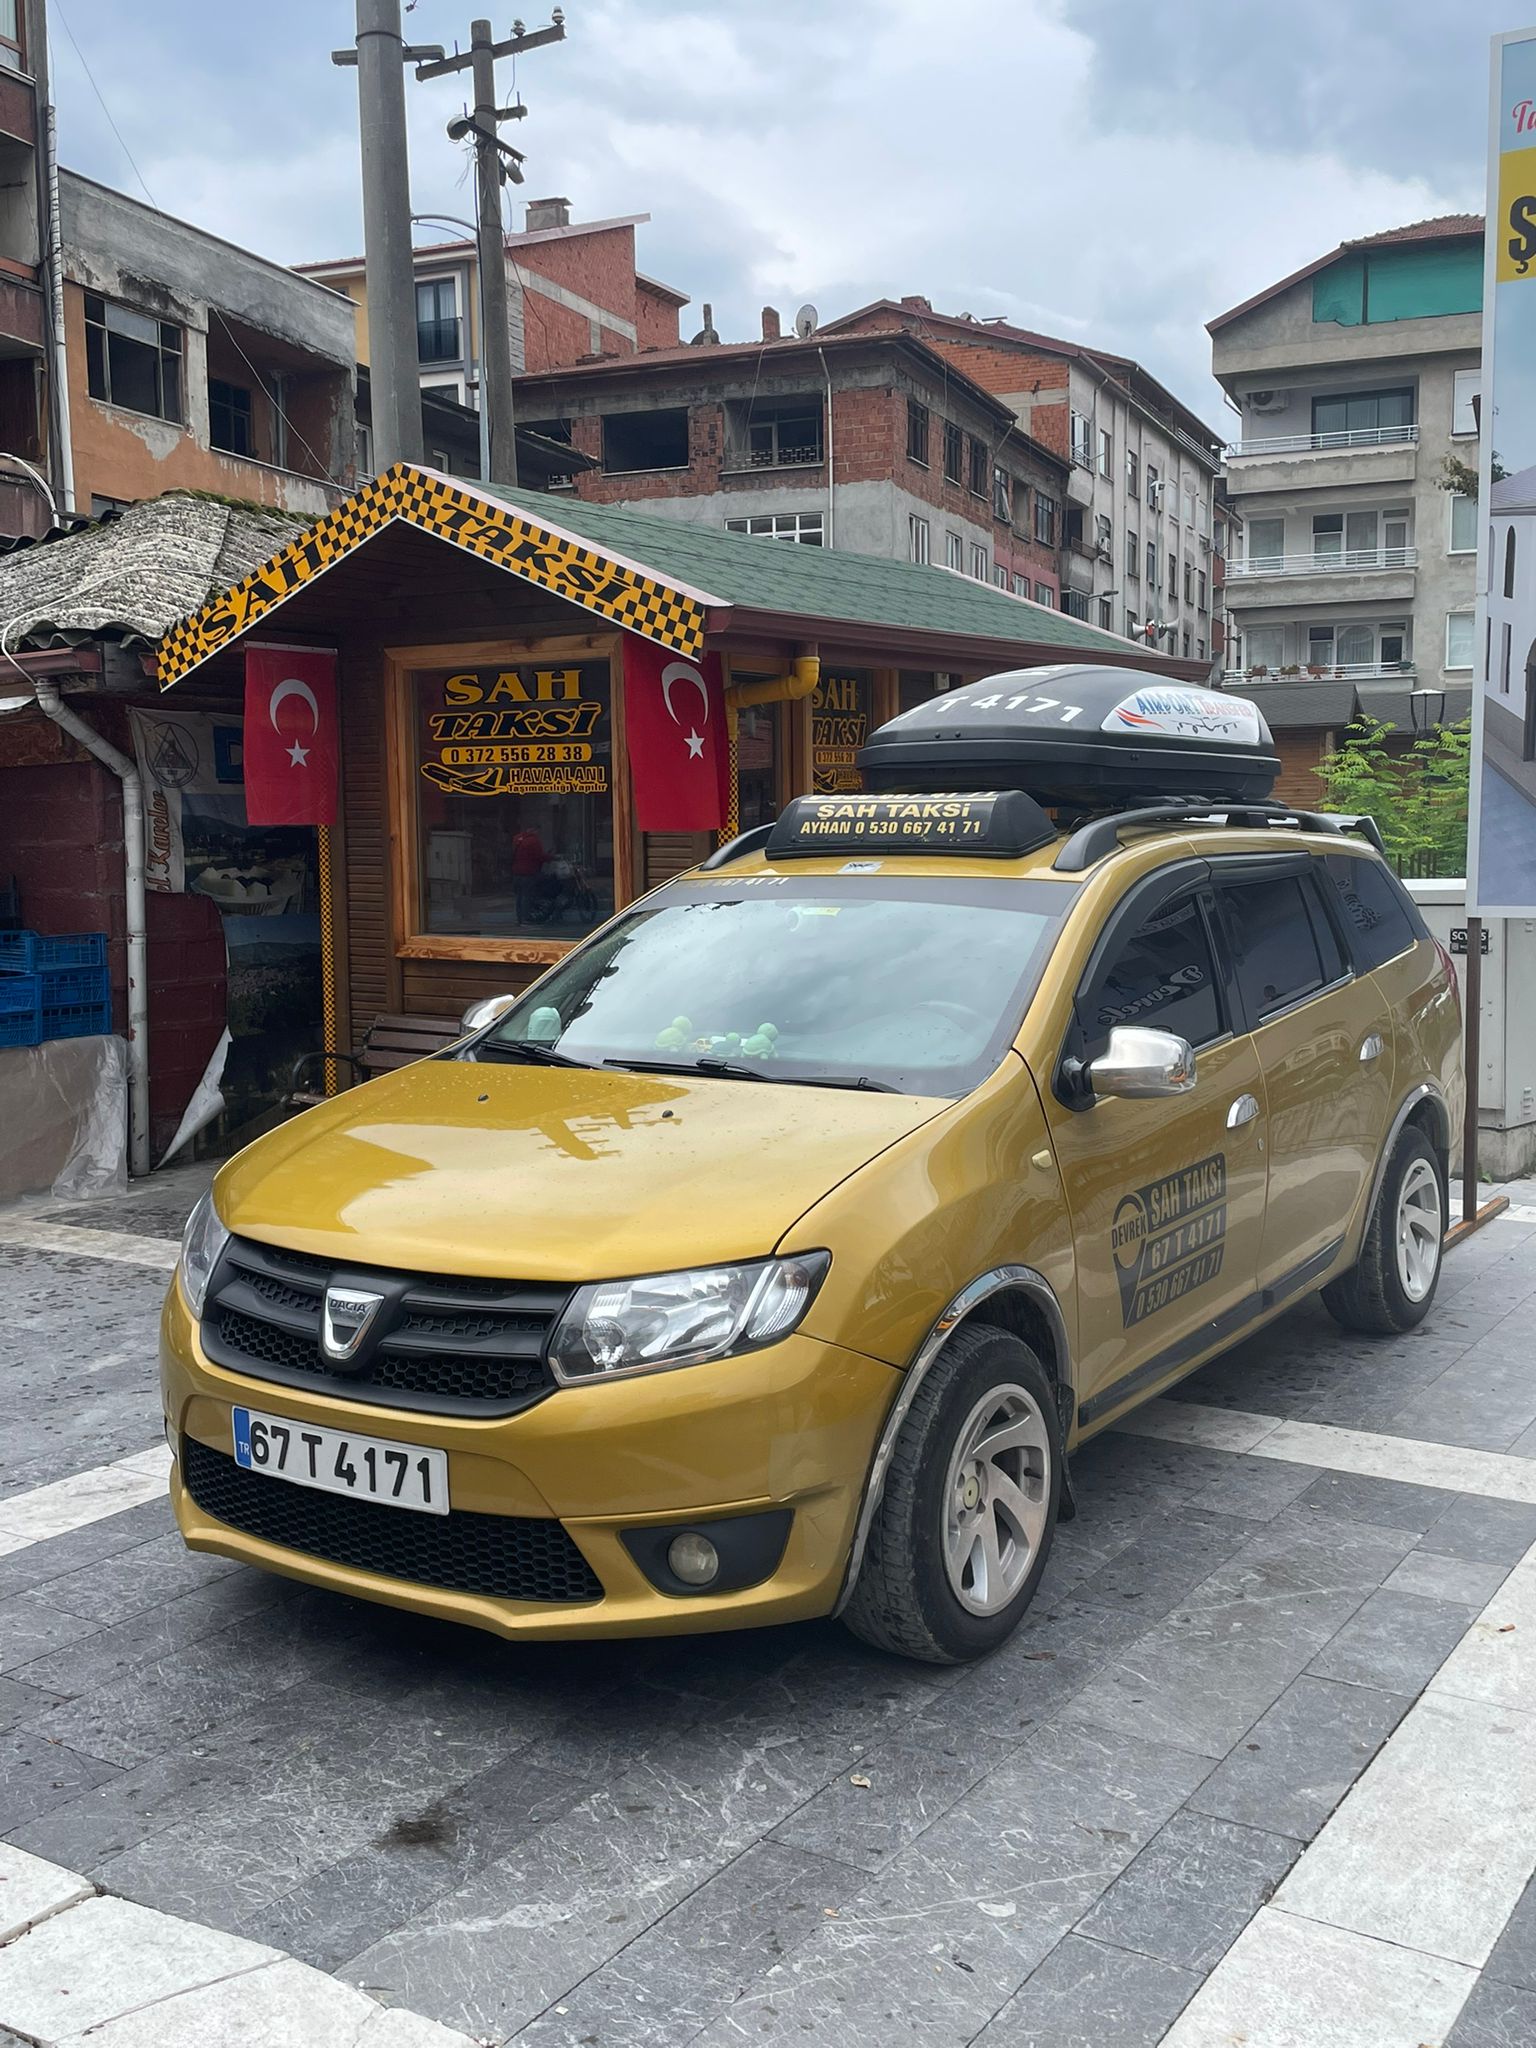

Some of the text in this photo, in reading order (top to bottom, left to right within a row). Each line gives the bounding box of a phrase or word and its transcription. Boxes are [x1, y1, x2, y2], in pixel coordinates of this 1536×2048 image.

[445, 669, 583, 706] SAH
[936, 695, 970, 713] T
[970, 694, 1084, 722] 4171
[451, 746, 583, 763] 0 372 556 28 38
[510, 766, 605, 783] HAVAALANI
[800, 821, 981, 835] AYHAN 0 530 667 41 71
[1111, 1214, 1147, 1249] DEVREK
[1151, 1210, 1221, 1270] 67 T 4171
[1136, 1249, 1220, 1319] 0 530 667 41 71
[329, 1298, 368, 1314] DACIA
[238, 1440, 250, 1456] TR
[251, 1420, 431, 1504] 67 T 4171
